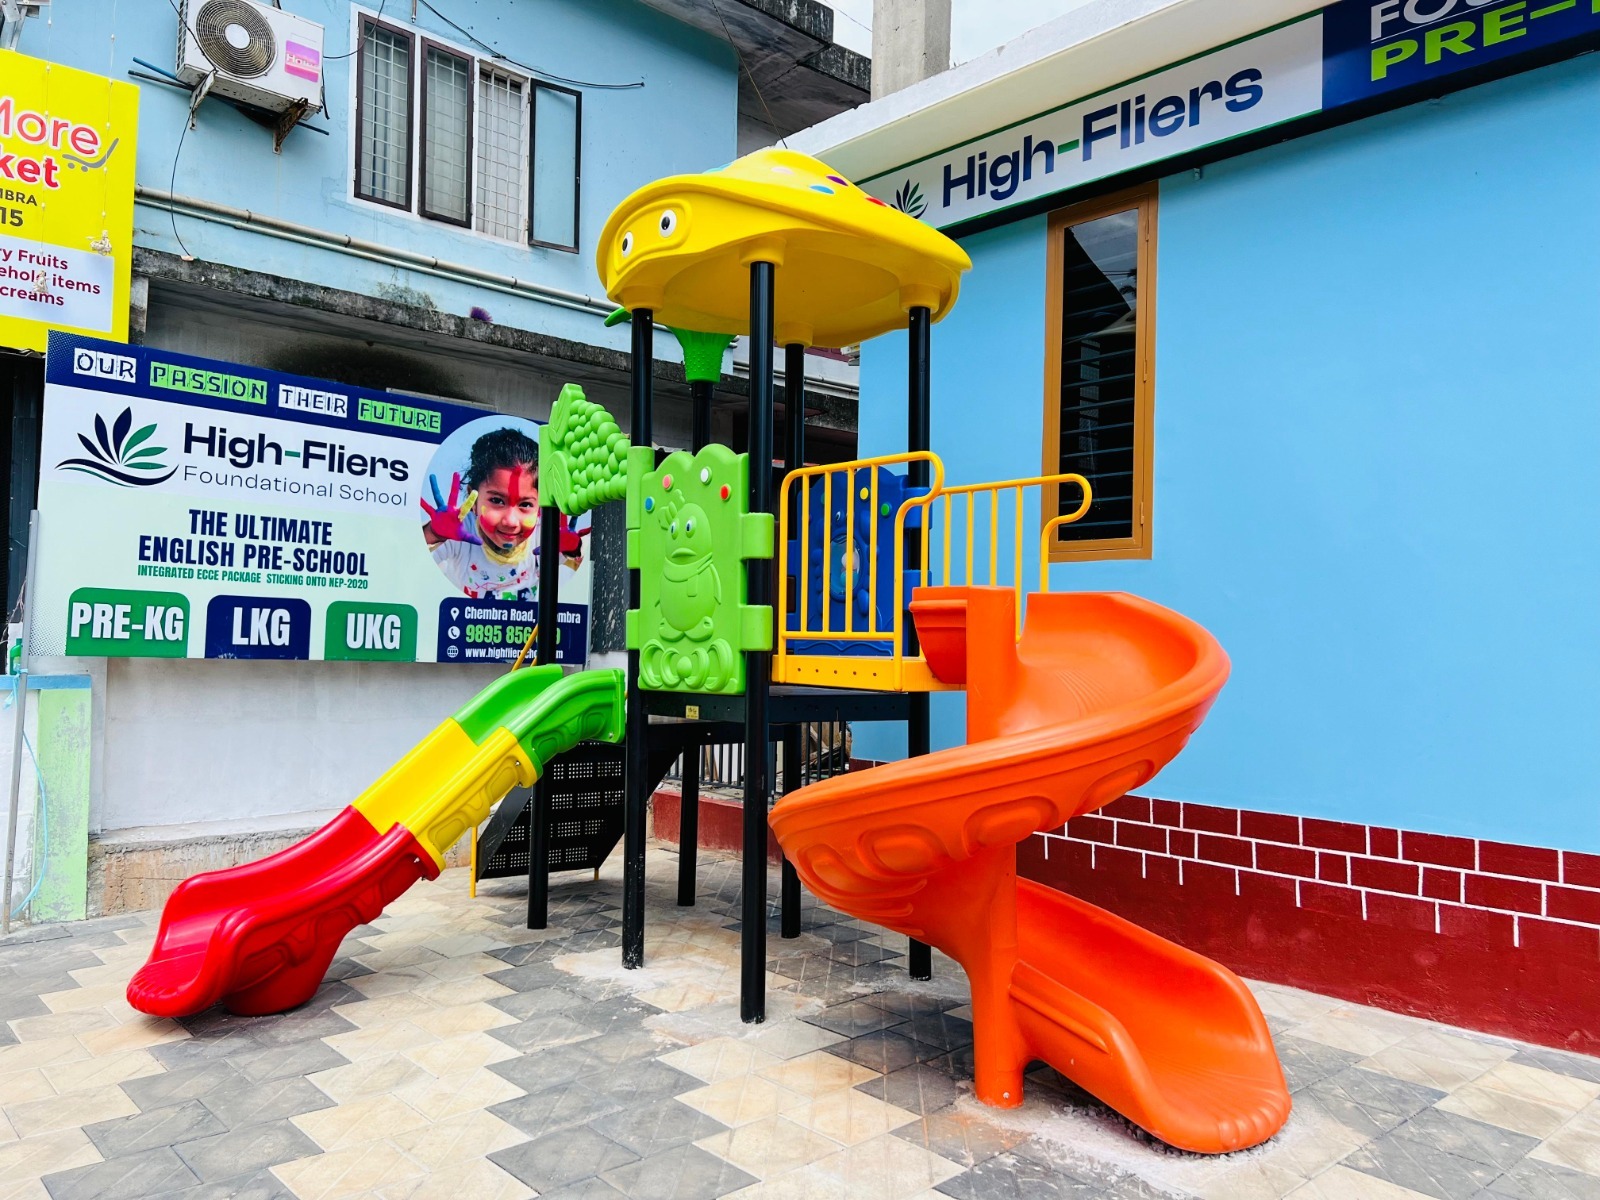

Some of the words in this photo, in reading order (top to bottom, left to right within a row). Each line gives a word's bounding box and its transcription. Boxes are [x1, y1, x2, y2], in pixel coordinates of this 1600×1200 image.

[1371, 0, 1502, 41] FO
[1371, 0, 1600, 82] PRE-
[0, 99, 99, 155] ore
[942, 67, 1263, 208] High-Fliers
[0, 188, 38, 207] BRA
[0, 248, 13, 262] y
[18, 249, 69, 270] Fruits
[52, 274, 101, 294] items
[76, 351, 136, 380] OUR
[152, 364, 266, 401] PASSION
[281, 387, 347, 415] THEIR
[359, 401, 440, 430] FUTURE
[183, 422, 409, 482] High-Fliers
[184, 465, 333, 498] Foundational
[339, 484, 408, 507] School
[188, 508, 228, 537] THE
[234, 513, 333, 546] ULTIMATE
[138, 534, 235, 567] ENGLISH
[243, 543, 369, 576] PRE-SCHOOL
[137, 564, 194, 579] INTEGRATED
[197, 568, 219, 581] ECCE
[221, 570, 262, 584] PACKAGE
[266, 573, 304, 586] STICKING
[305, 575, 327, 588] ONTO
[328, 577, 368, 590] NEP-2020
[70, 602, 184, 641] PRE-KG
[231, 606, 291, 646] LKG
[346, 612, 400, 650] UKG
[464, 606, 508, 621] Chembra
[510, 608, 536, 623] Road,
[465, 624, 502, 644] 9895
